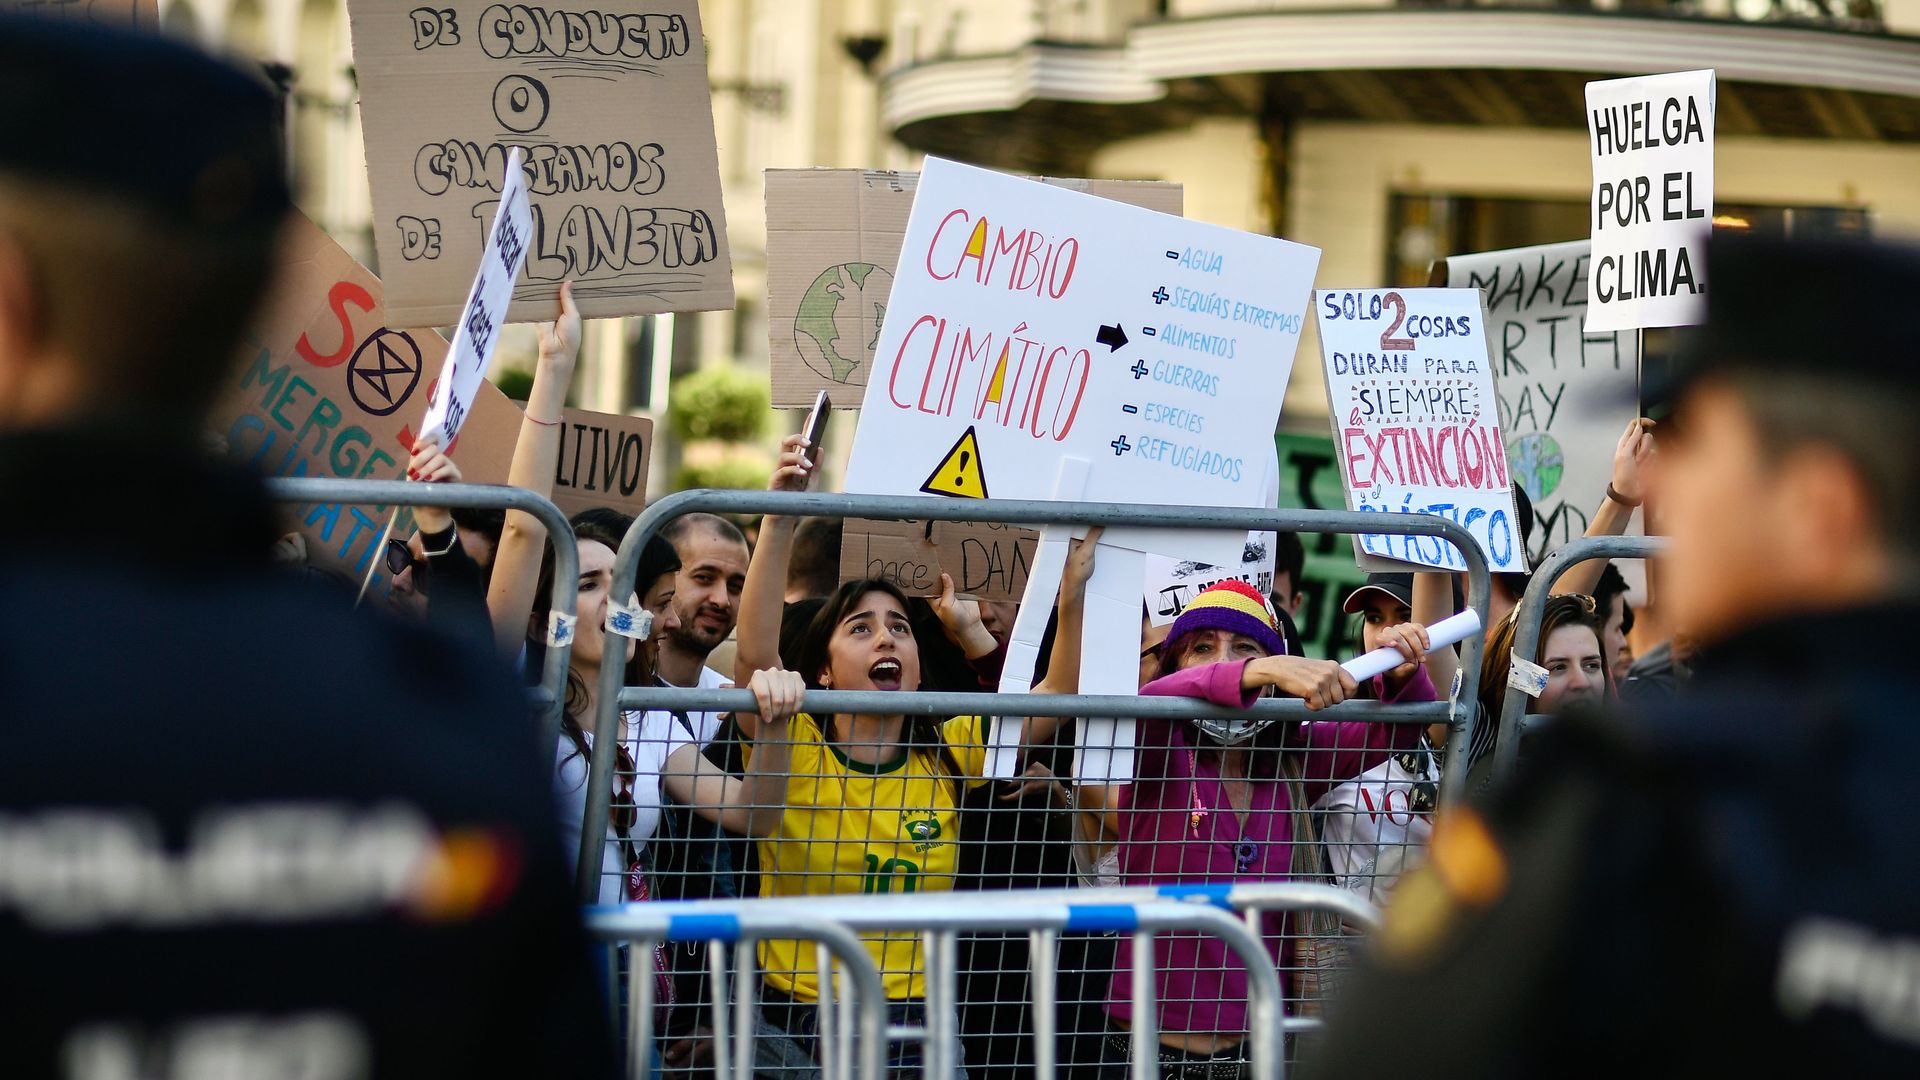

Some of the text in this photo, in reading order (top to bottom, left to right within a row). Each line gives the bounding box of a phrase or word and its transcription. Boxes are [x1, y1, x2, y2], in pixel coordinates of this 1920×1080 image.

[410, 4, 690, 59] DE CONDUCTA
[492, 74, 550, 133] O
[1593, 95, 1705, 156] HUELGA
[1598, 171, 1706, 230] POR EL
[396, 215, 441, 261] DE
[926, 208, 1079, 299] CAMBIO
[1178, 247, 1223, 276] AGUA
[1467, 253, 1592, 313] MAKE
[1595, 247, 1706, 304] CLIMA.
[1170, 286, 1231, 320] SEQUÍAS
[1232, 301, 1301, 335] EXTREMAS
[1324, 291, 1471, 351] SOLO 2 COSAS
[1160, 323, 1238, 360] ALIMENTOS
[1333, 352, 1479, 376] DURAN PARA
[1502, 316, 1620, 377] RTH
[889, 314, 1091, 442] CLIMÁTICO
[1152, 360, 1220, 397] GUERRAS
[1359, 387, 1472, 415] SIEMPRE
[1144, 402, 1205, 434] ESPECIES
[1135, 436, 1244, 483] REFUGIADOS
[1344, 418, 1508, 490] EXTINCIÓN
